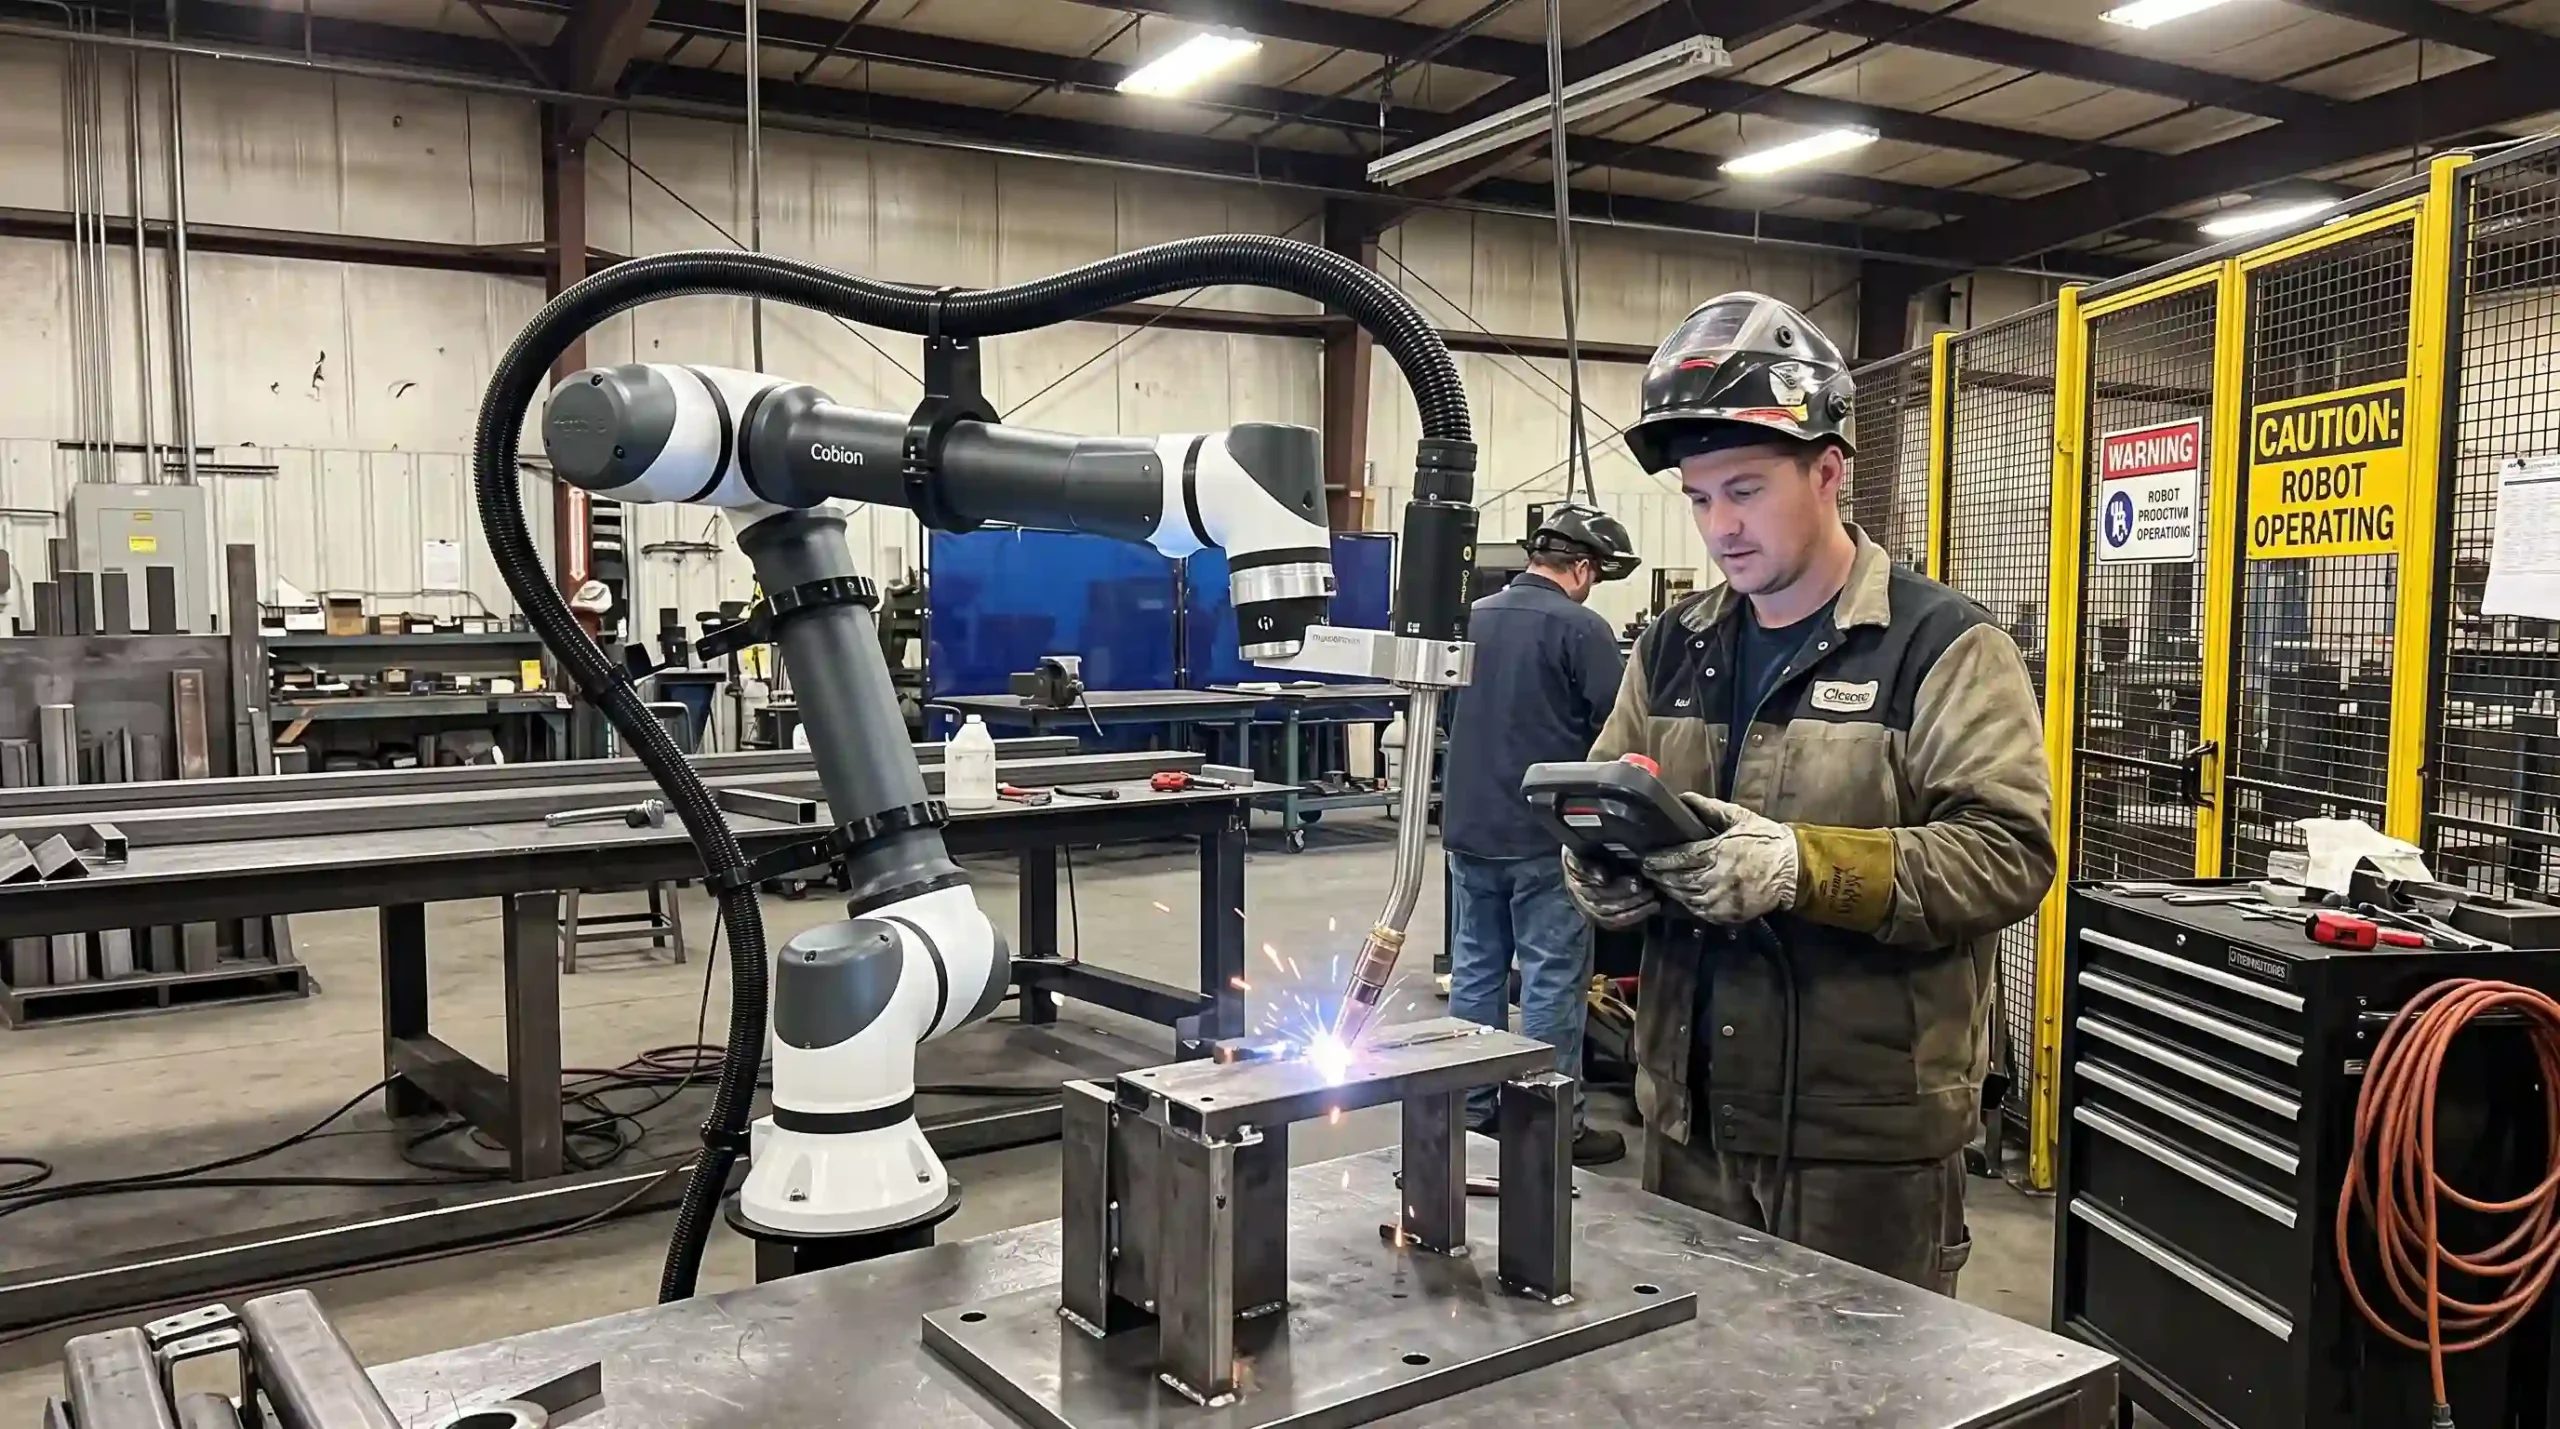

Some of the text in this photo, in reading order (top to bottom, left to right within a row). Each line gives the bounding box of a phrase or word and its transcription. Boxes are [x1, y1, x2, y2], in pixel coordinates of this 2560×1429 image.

[2259, 398, 2399, 457] CAUTION:
[811, 443, 863, 465] Cobion
[2108, 432, 2193, 472] WARNING
[2148, 487, 2180, 503] ROBOT
[2282, 461, 2367, 504] ROBOT
[2254, 504, 2394, 548] OPERATING
